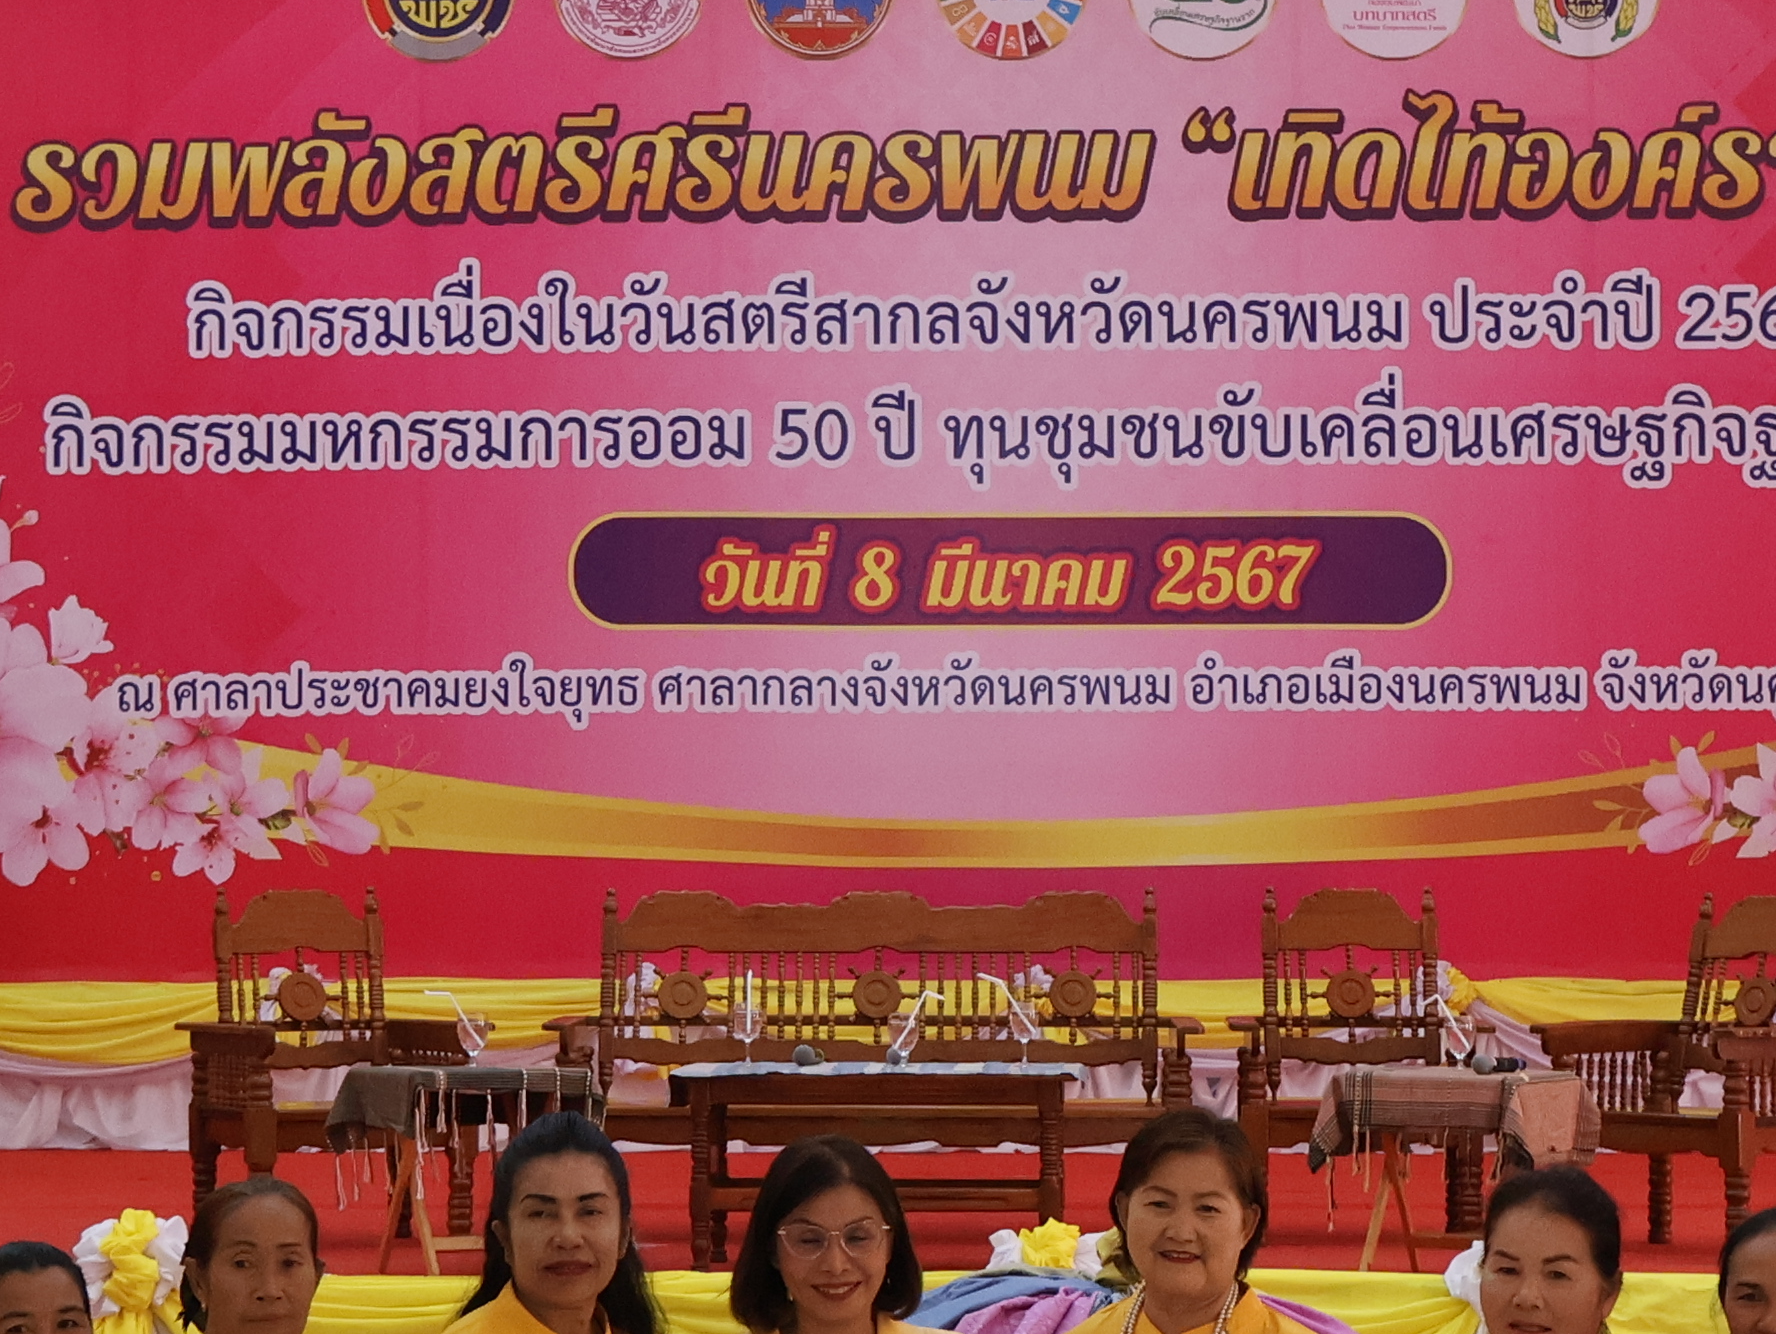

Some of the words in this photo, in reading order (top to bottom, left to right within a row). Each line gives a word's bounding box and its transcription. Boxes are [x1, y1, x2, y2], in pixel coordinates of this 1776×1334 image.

[1353, 8, 1437, 22] บทบาทสตรี
[14, 105, 1154, 227] รวมพลังสตรีศรีนครพนม
[193, 264, 1402, 351] กิจกรรมเนื่องในวันสตรีสากลจังหวัดนครพนม
[1429, 274, 1653, 344] ประจำปี
[50, 401, 745, 468] กิจกรรมมหกรรมการออม
[775, 408, 849, 461] 50
[871, 389, 915, 461] ปี
[705, 531, 831, 607] วันที่
[854, 546, 895, 607] 8
[926, 543, 1127, 608] มีนาคม
[1156, 544, 1315, 606] 2567
[117, 681, 155, 713] ณ
[173, 658, 639, 723] ศาลาประชาคมยงใจยุทธ
[658, 658, 1170, 708] ศาลากลางจังหวัดนครพนม
[1190, 655, 1580, 707] อำเภอเมืองนครพนม
